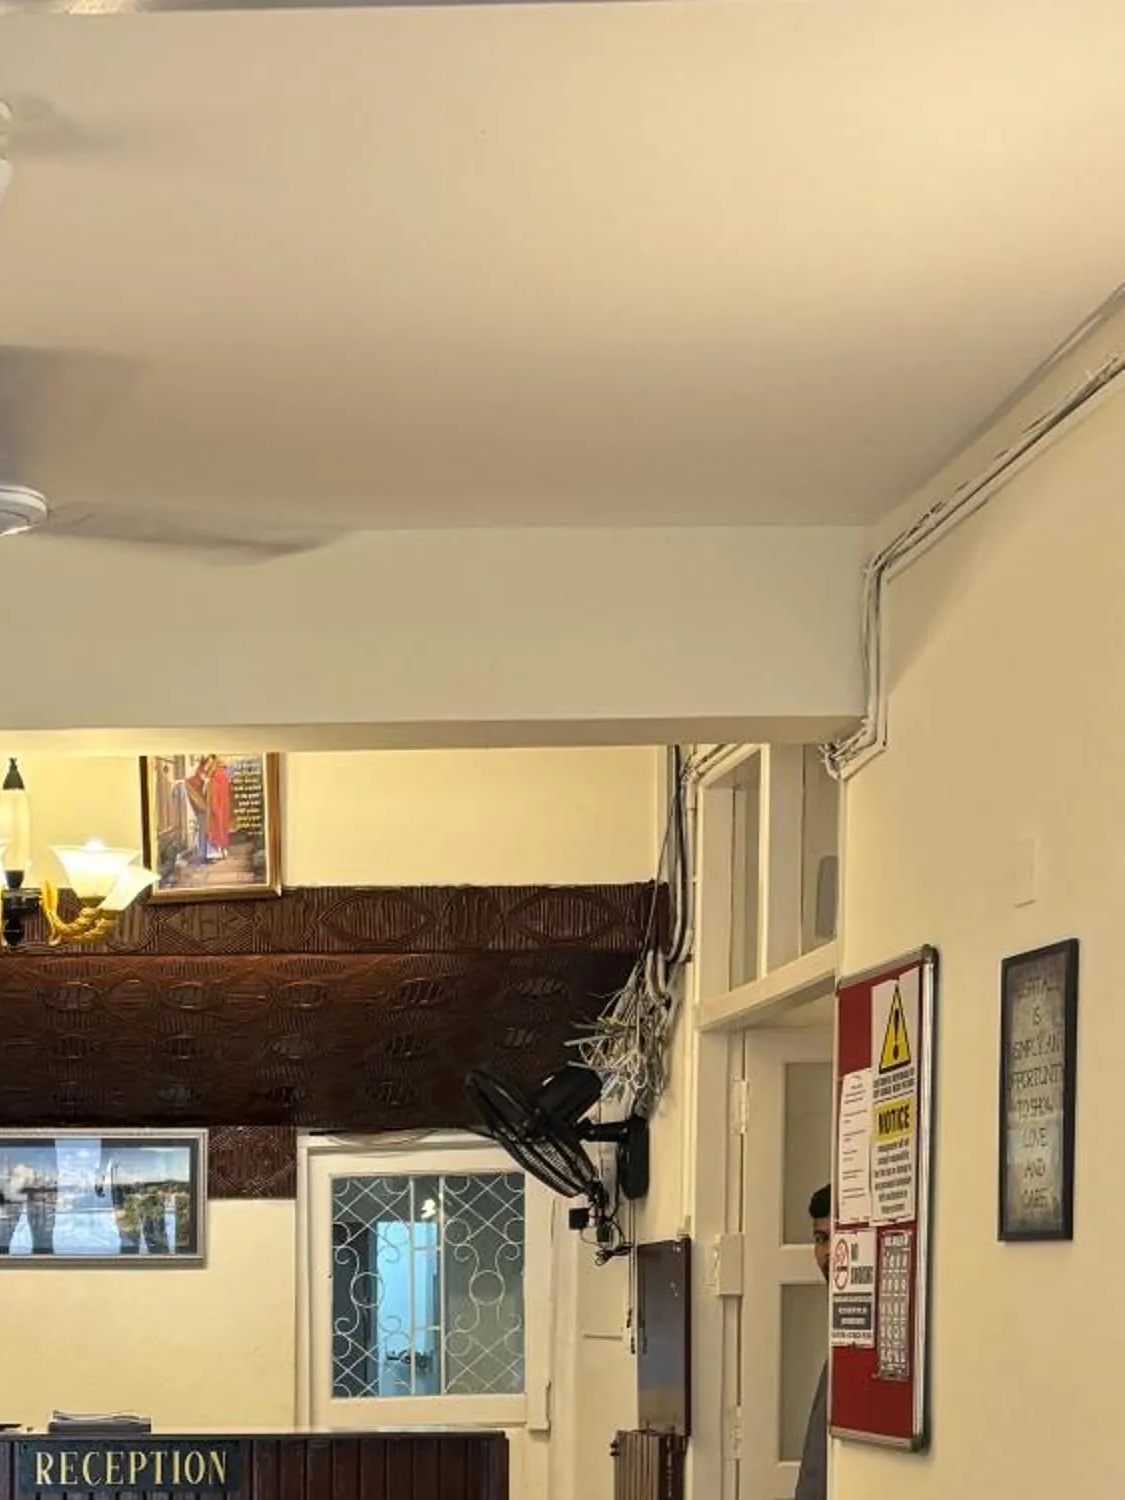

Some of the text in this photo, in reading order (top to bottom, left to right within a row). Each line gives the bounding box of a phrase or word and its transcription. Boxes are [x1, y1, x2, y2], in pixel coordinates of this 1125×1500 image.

[878, 1104, 910, 1136] NOTICE
[1024, 1158, 1046, 1178] AND
[35, 1451, 226, 1486] RECEPTION
